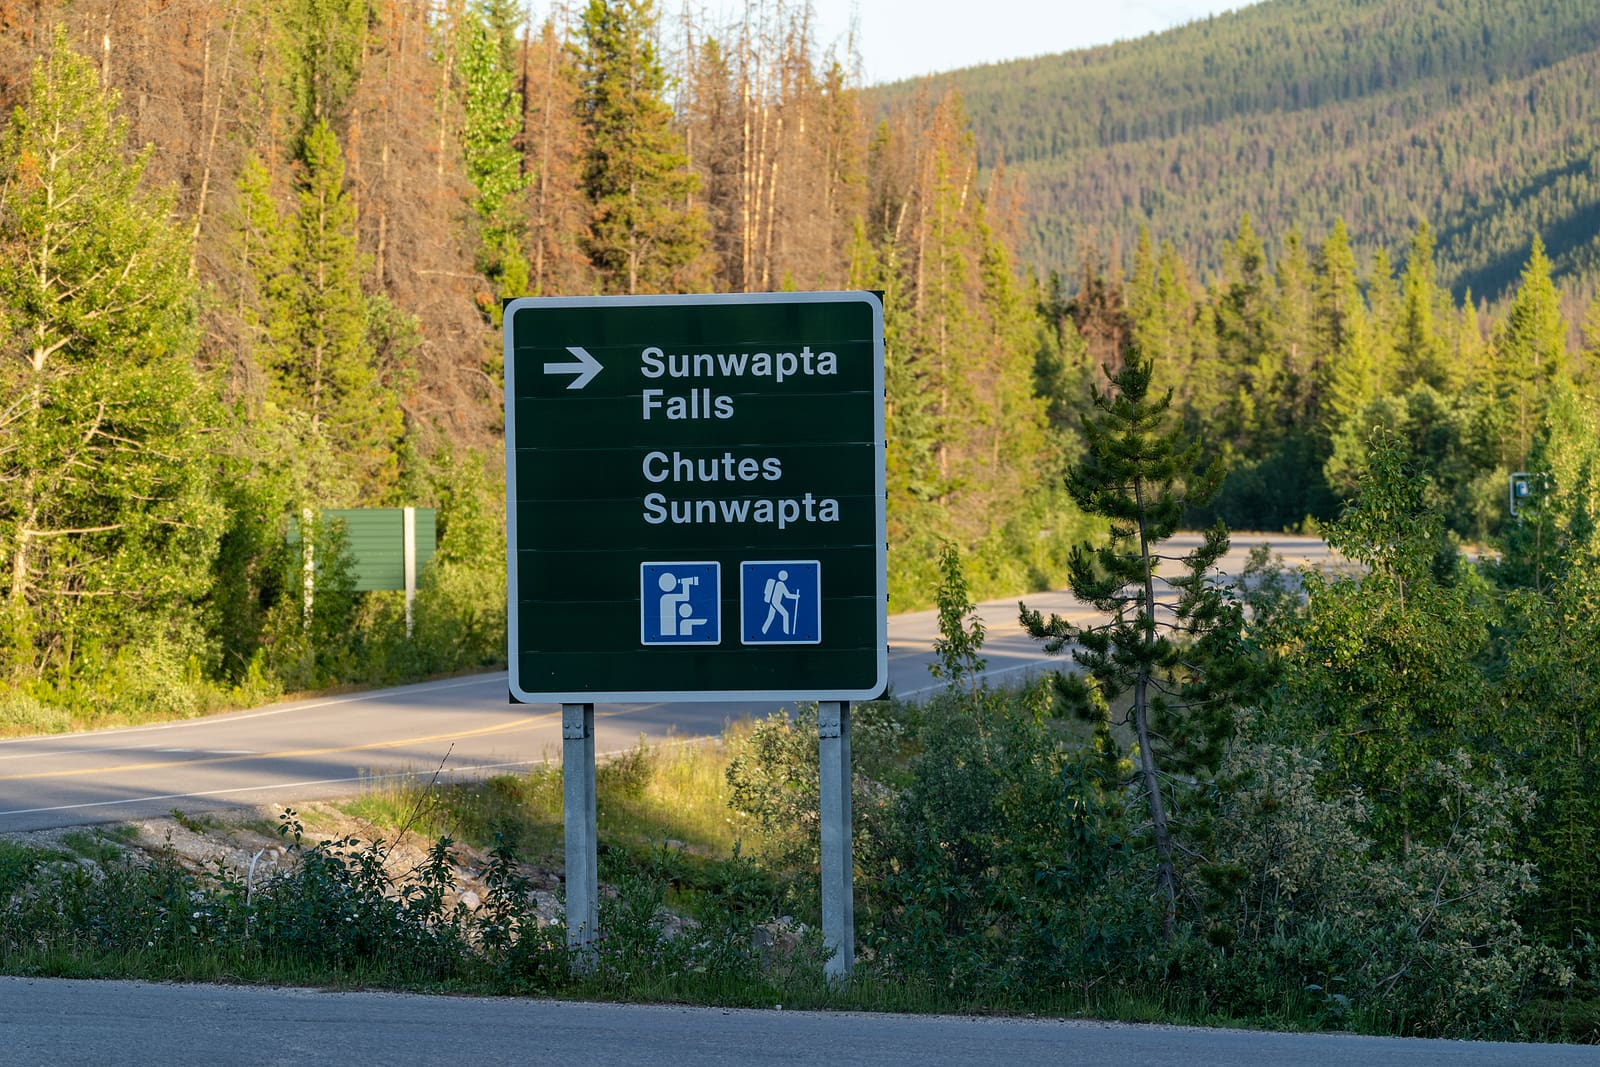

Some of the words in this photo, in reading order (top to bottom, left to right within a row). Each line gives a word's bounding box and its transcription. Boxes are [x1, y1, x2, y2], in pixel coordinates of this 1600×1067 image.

[640, 346, 838, 383] Sunwapta
[642, 388, 734, 420] Falls
[642, 451, 782, 483] Chutes
[643, 492, 840, 530] Sunwapta
